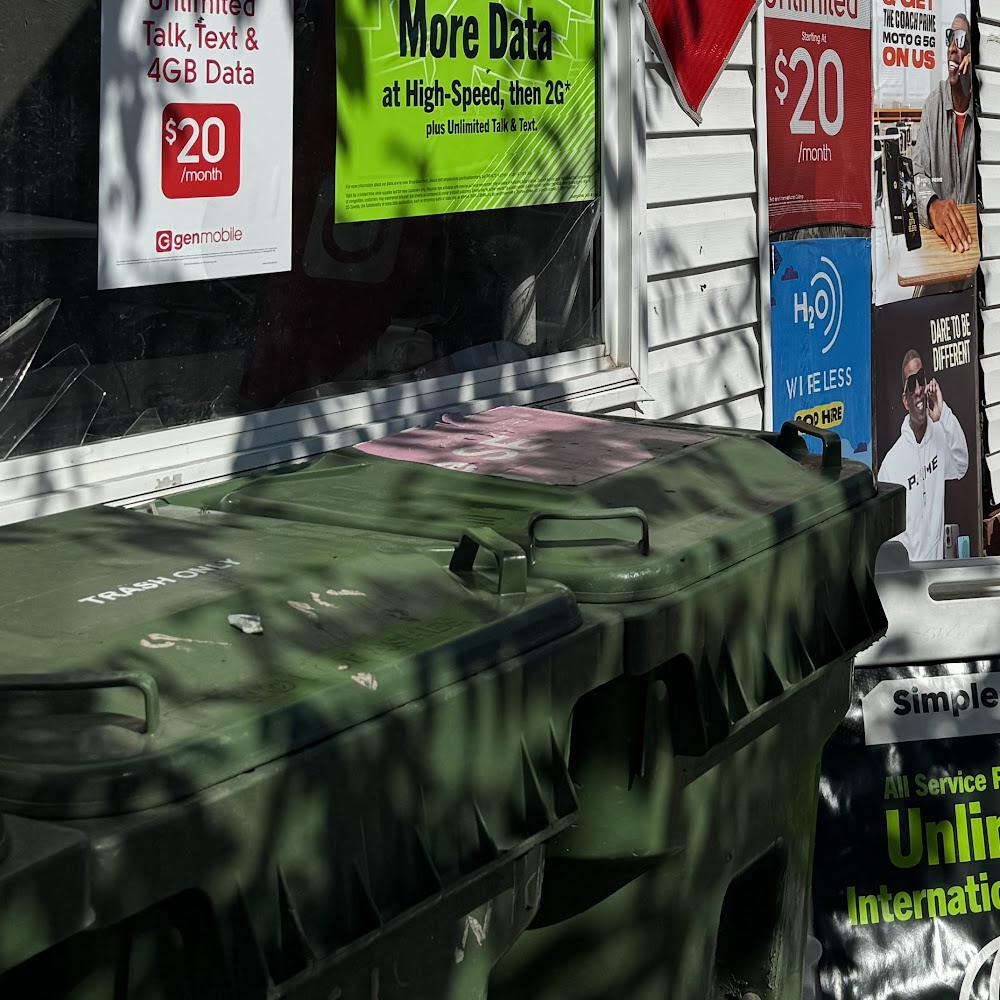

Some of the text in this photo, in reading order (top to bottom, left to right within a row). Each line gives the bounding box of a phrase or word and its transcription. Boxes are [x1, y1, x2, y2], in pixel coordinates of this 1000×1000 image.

[489, 1, 552, 61] Data
[883, 8, 936, 32] THE COACH PRIME
[142, 20, 260, 52] Talk, Text &
[801, 31, 821, 44] Starting
[882, 31, 936, 48] MOTO G 5G
[147, 57, 256, 85] 4GB Data
[882, 47, 936, 70] ON US
[382, 86, 401, 107] at
[405, 79, 505, 113] High-Speed,
[509, 82, 542, 106] then
[774, 47, 844, 136] $20
[165, 116, 226, 164] $20
[426, 121, 446, 138] plus
[447, 119, 490, 135] Unlimited
[491, 118, 509, 133] Talk
[510, 119, 517, 132] &
[798, 142, 832, 163] /month
[180, 166, 223, 183] /month
[173, 226, 243, 250] genmobile
[930, 313, 971, 344] DARE TO BE
[932, 339, 971, 372] DIFFERENT
[77, 557, 241, 605] TRASH ONLY
[893, 681, 999, 717] Simple
[884, 775, 910, 799] All
[915, 770, 987, 797] Service
